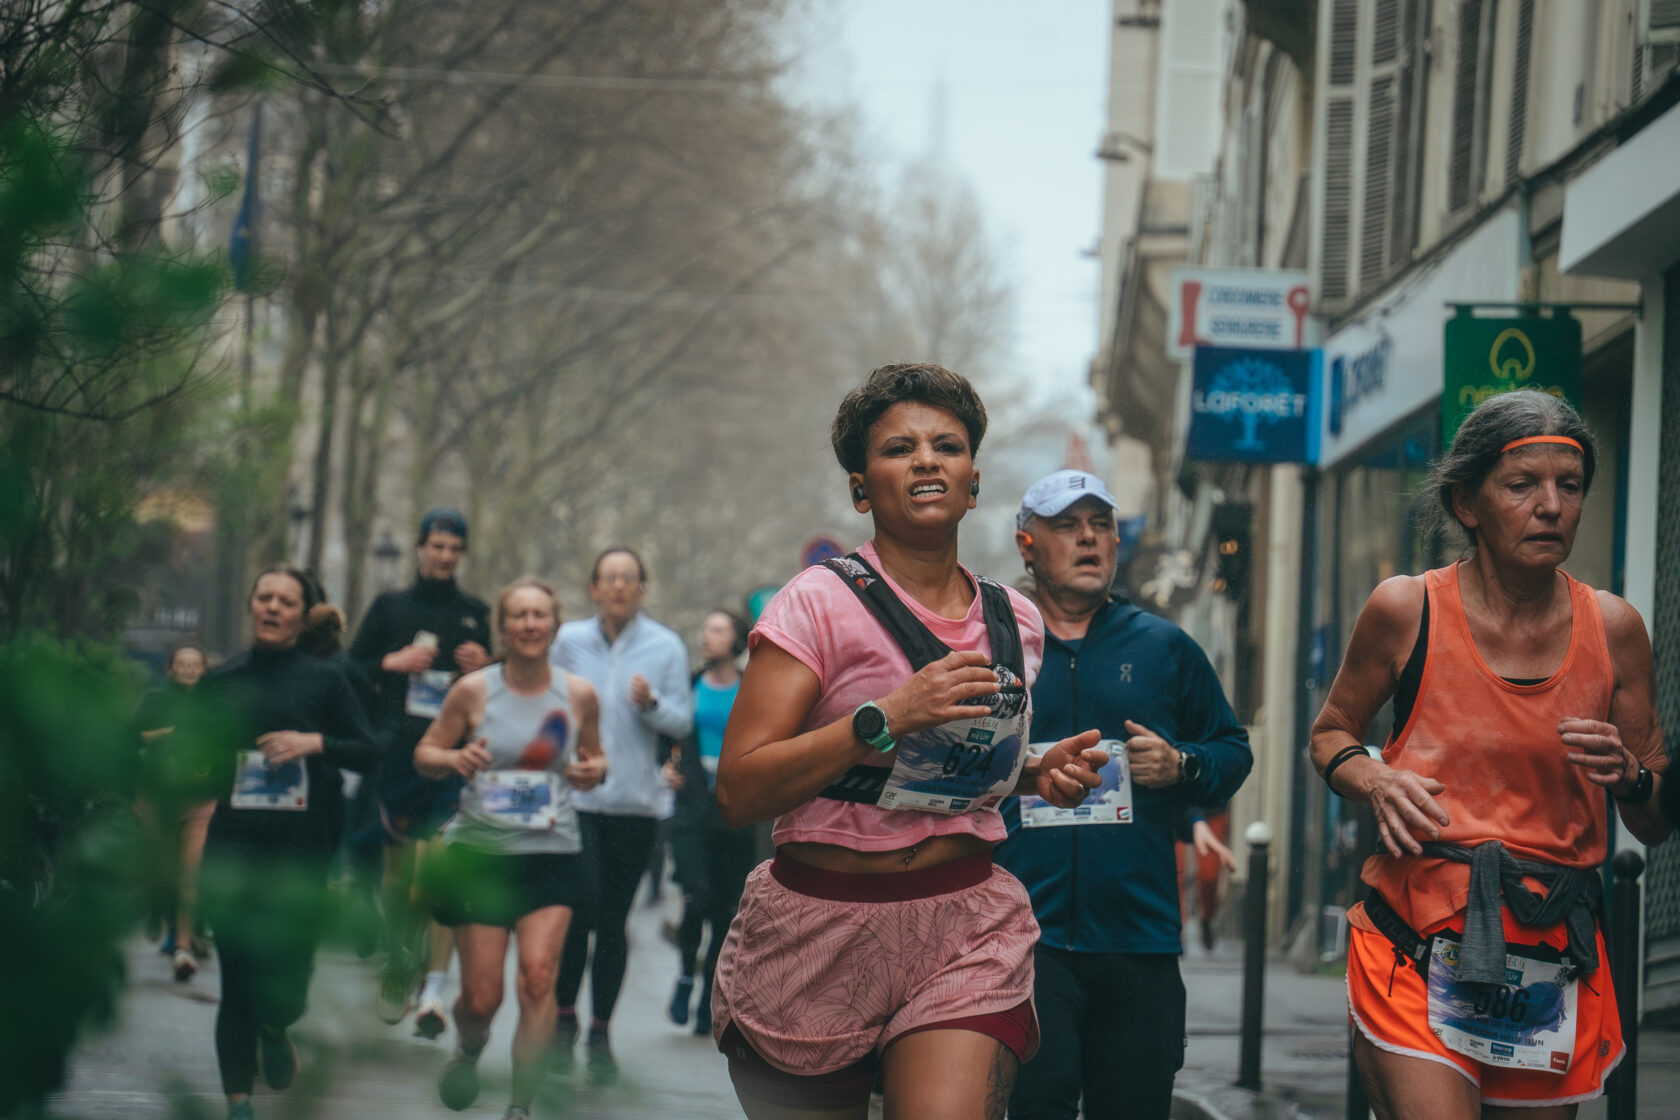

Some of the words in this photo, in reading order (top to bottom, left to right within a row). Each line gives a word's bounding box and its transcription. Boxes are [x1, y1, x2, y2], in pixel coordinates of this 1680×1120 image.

[943, 742, 997, 779] 624
[1500, 1033, 1523, 1043] NEUF
[1525, 1038, 1544, 1047] RUN
